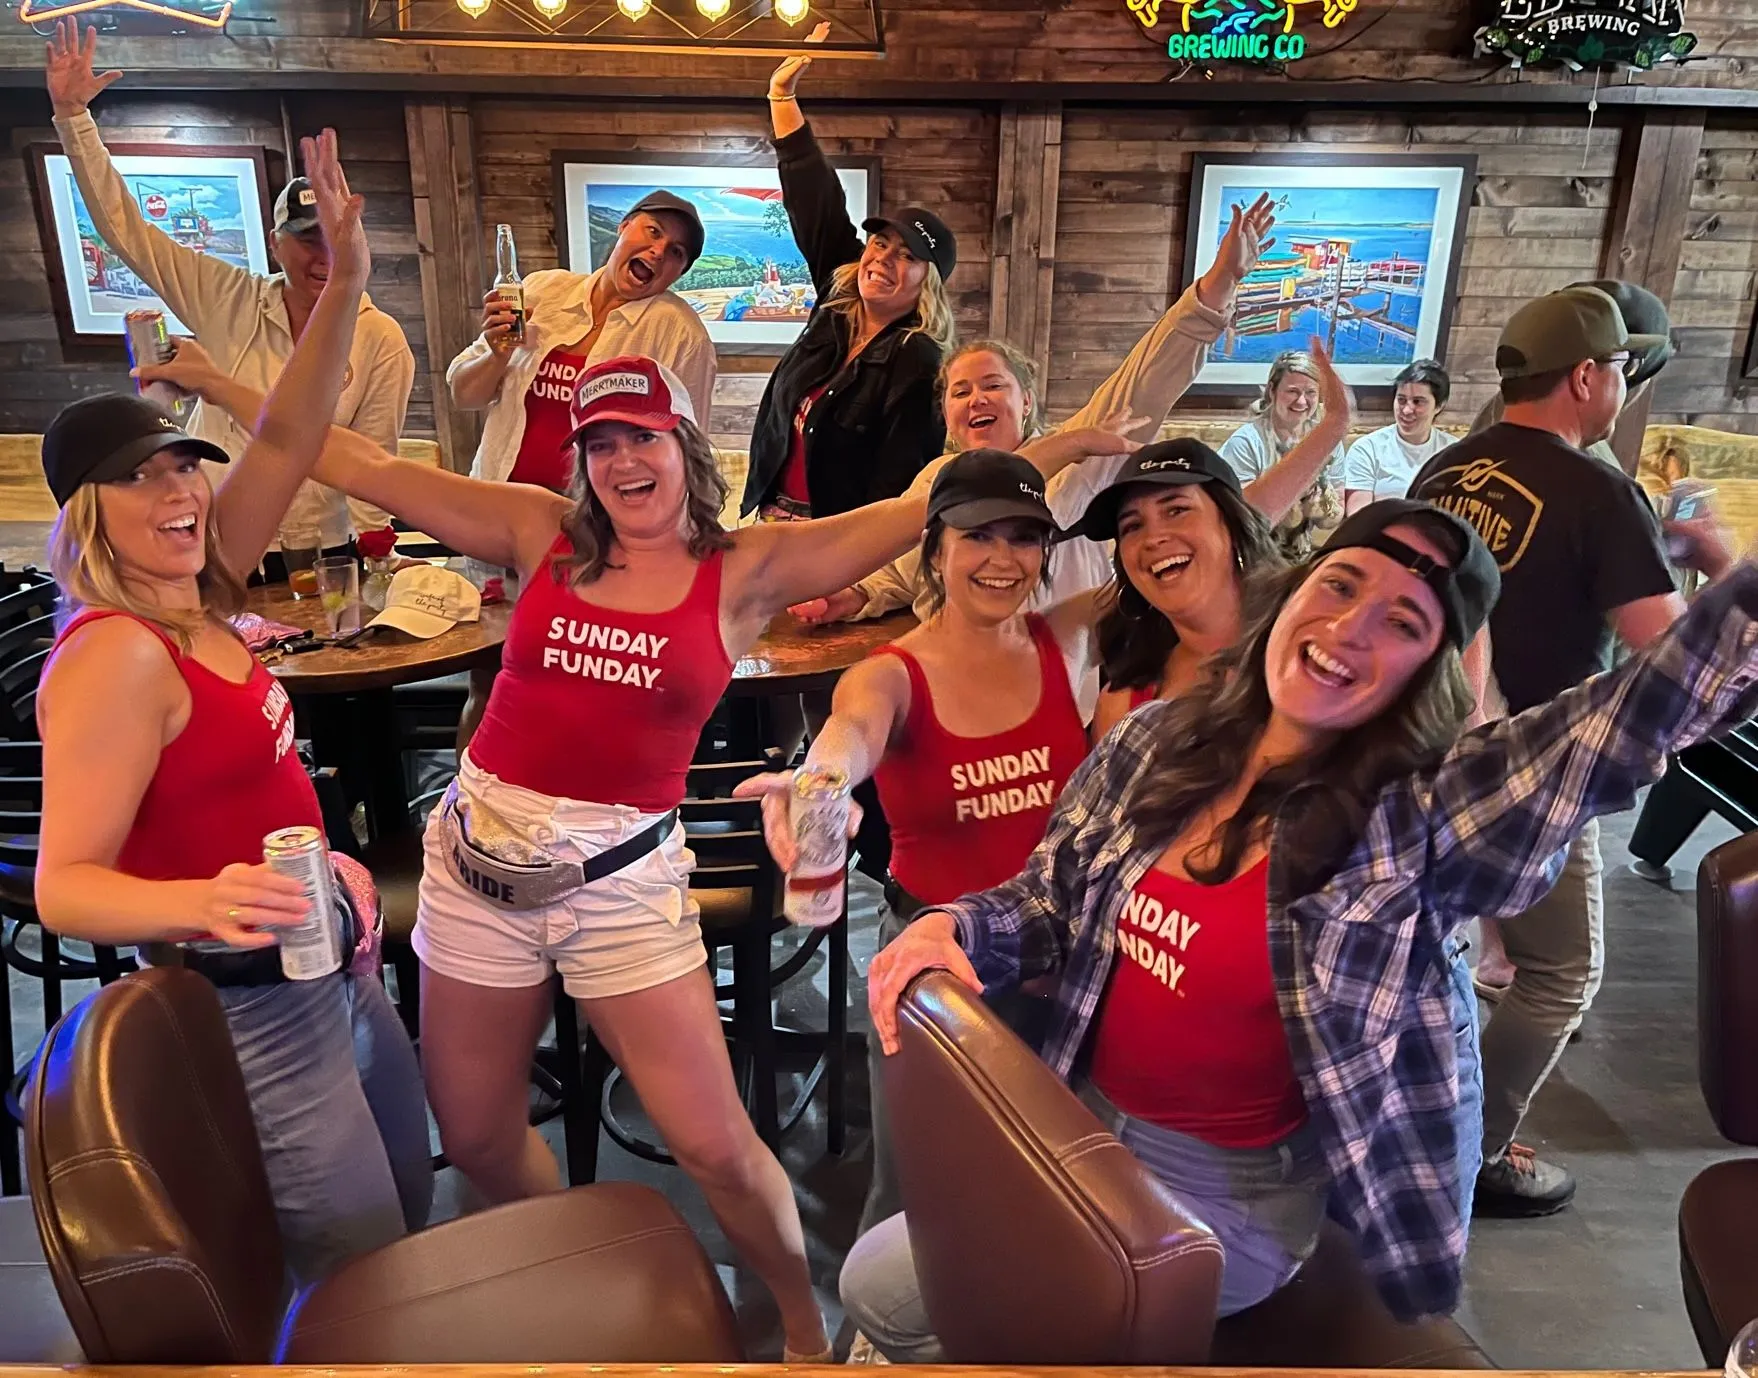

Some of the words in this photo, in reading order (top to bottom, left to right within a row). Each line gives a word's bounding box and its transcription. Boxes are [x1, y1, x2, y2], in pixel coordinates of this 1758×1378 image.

[1168, 34, 1268, 58] BREWING
[1274, 34, 1305, 58] CO
[1548, 14, 1640, 36] BREWING
[582, 376, 646, 402] MERRYMAKER
[547, 616, 669, 659] SUNDAY
[543, 647, 662, 689] FUNDAY
[951, 746, 1050, 791] SUNDAY
[956, 779, 1055, 822] FUNDAY
[1116, 928, 1186, 991] NDAY
